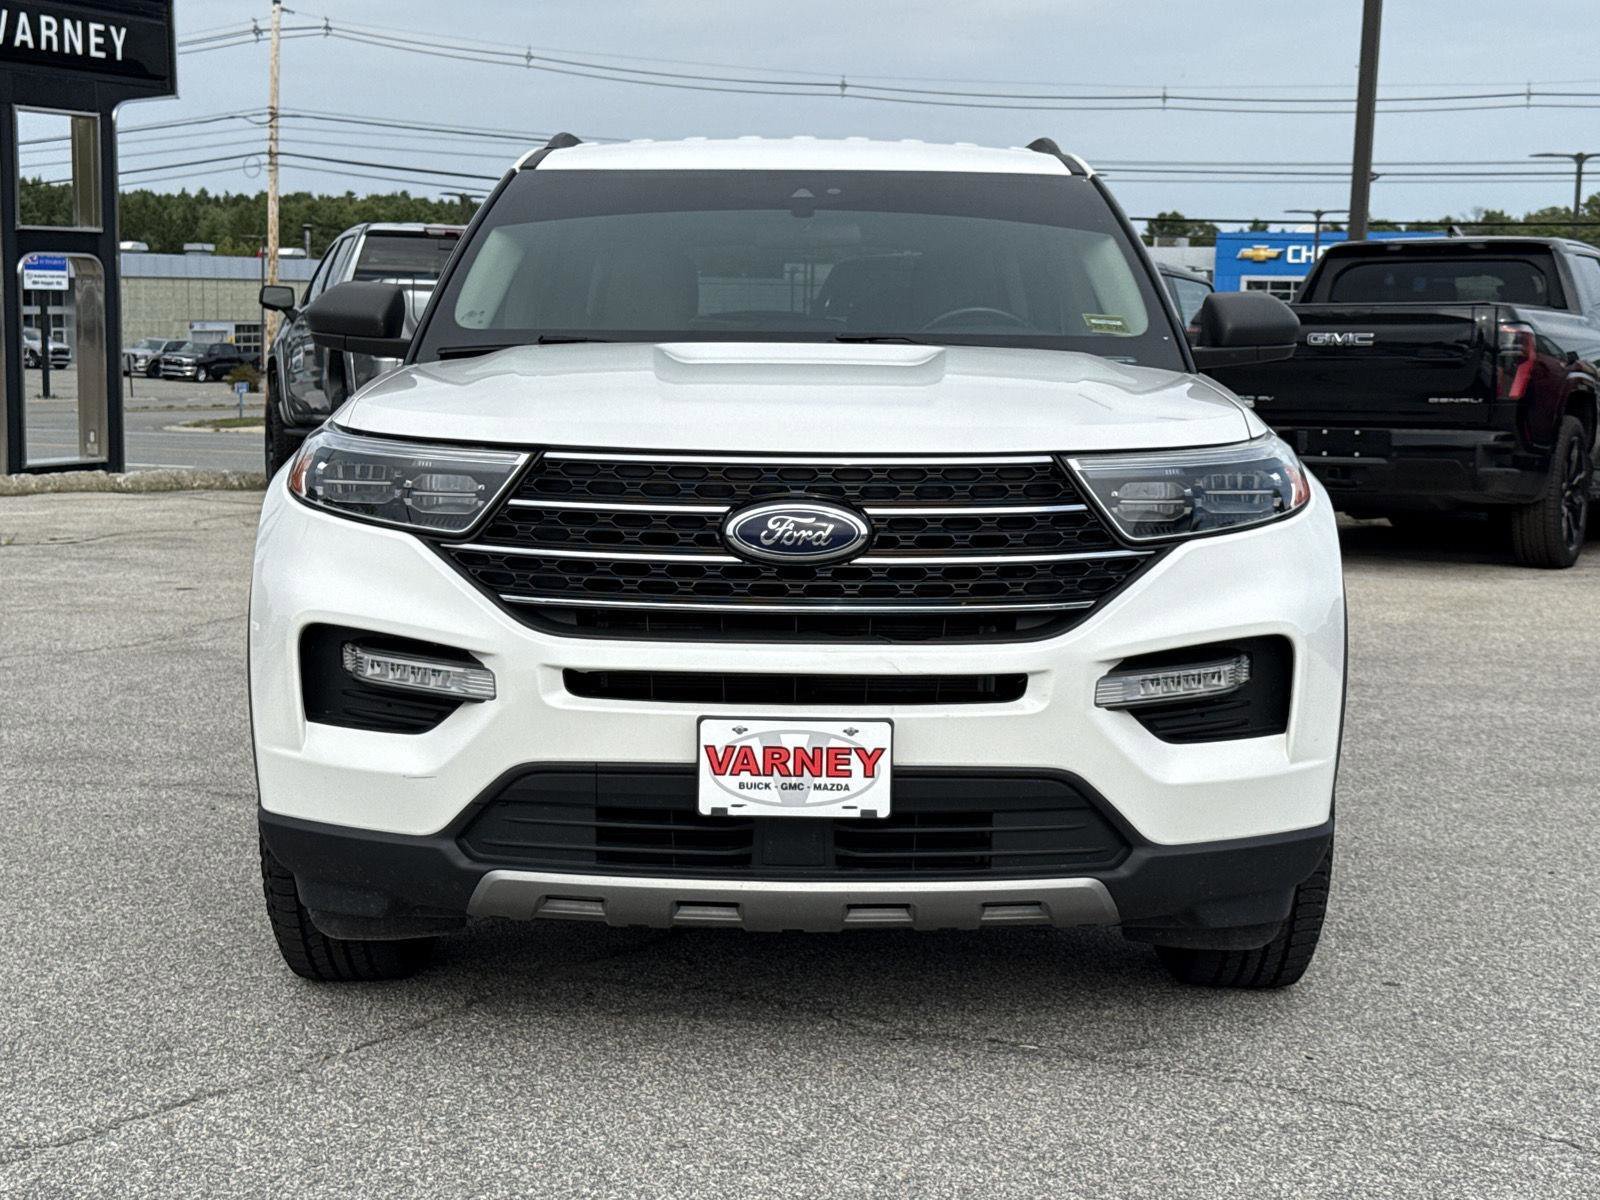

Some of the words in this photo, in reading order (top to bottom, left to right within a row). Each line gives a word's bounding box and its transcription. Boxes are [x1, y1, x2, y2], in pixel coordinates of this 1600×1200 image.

[1306, 332, 1375, 346] GMC
[759, 515, 835, 546] Ford
[703, 744, 887, 779] VARNEY
[738, 781, 772, 791] BUICK
[780, 782, 805, 791] GMC
[813, 782, 850, 792] MAZDA
